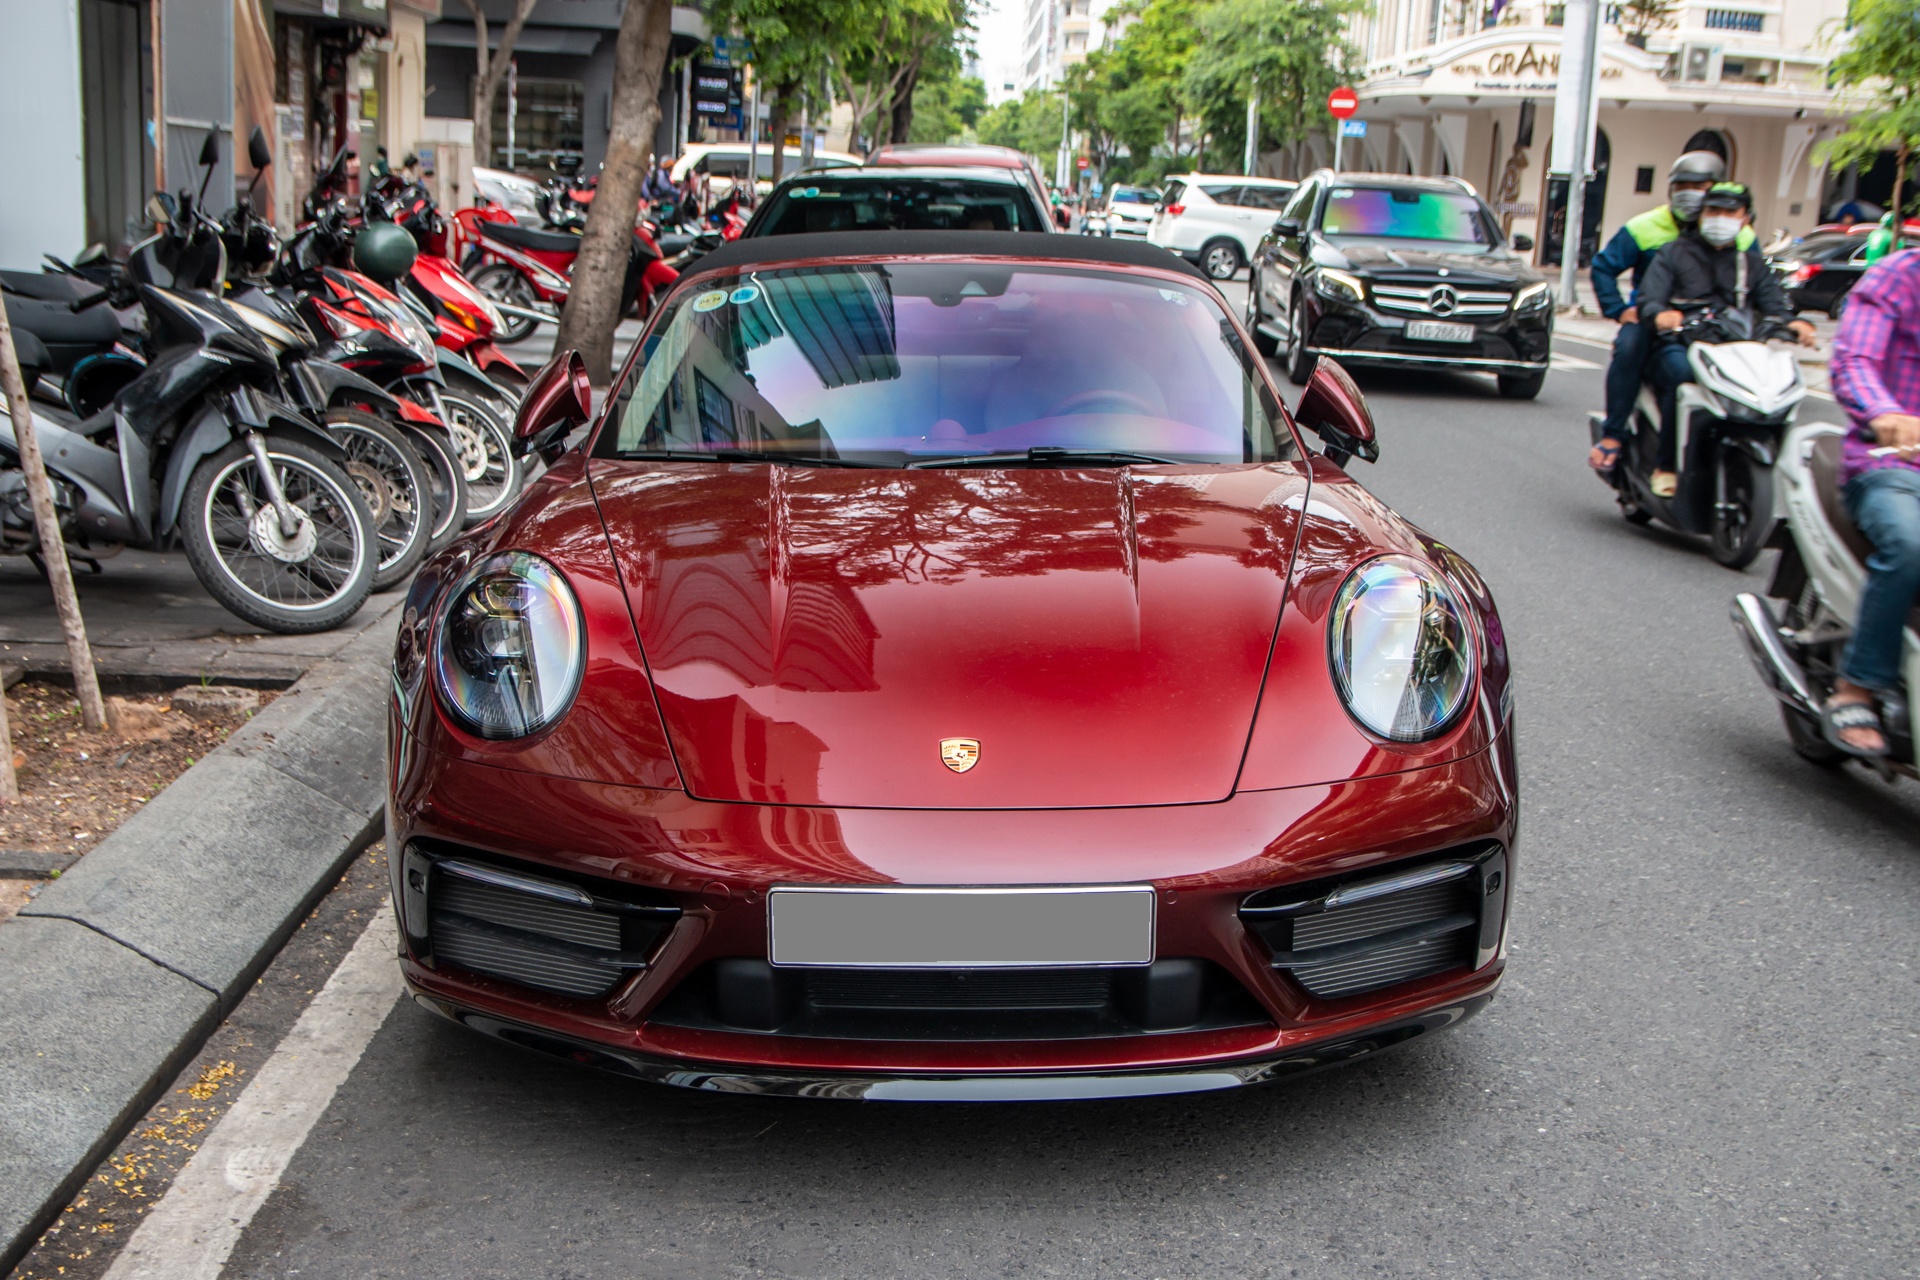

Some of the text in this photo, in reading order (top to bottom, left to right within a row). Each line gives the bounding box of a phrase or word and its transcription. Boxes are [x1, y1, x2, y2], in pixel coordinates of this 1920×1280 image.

[1488, 43, 1561, 76] GRAN
[439, 324, 465, 342] HONDA
[199, 350, 232, 365] HONDA
